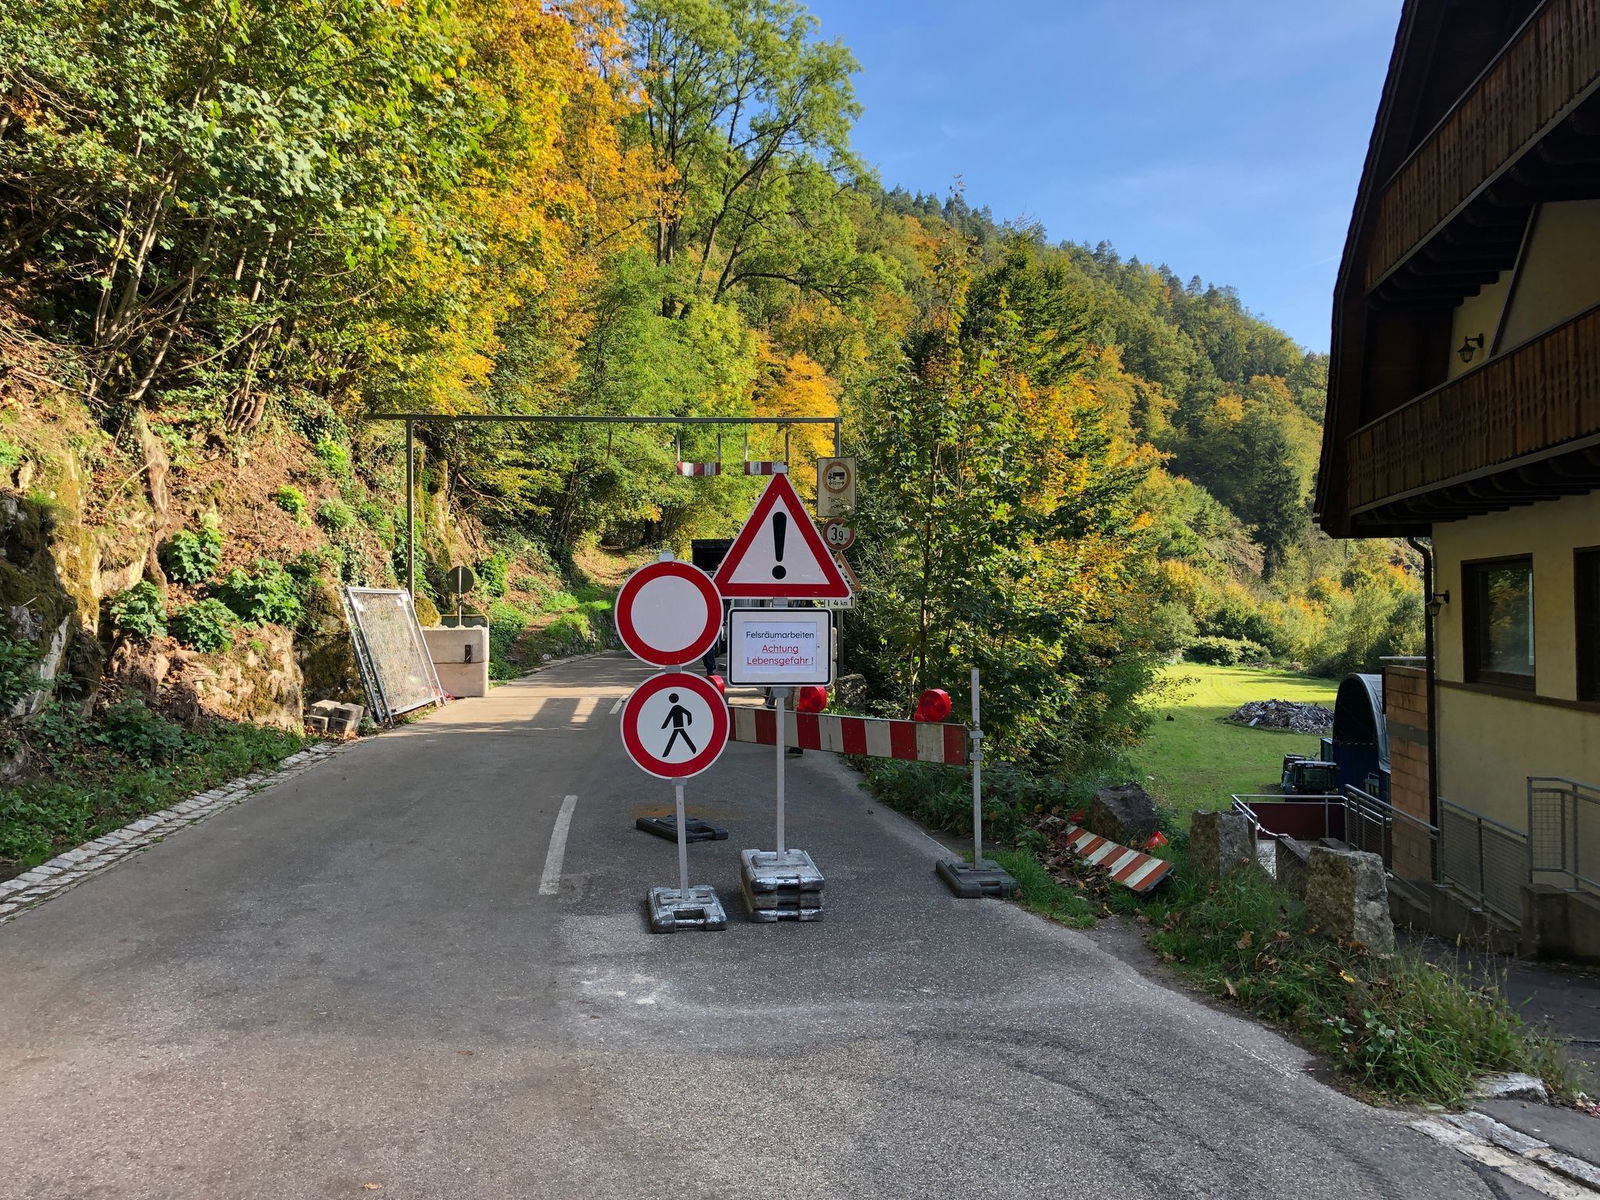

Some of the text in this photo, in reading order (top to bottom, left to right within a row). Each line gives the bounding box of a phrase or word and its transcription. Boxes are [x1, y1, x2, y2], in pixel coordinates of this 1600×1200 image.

[745, 631, 815, 639] Felsräumarbeiten
[761, 644, 799, 655] Achtung
[746, 657, 809, 667] Lebensgefahr
